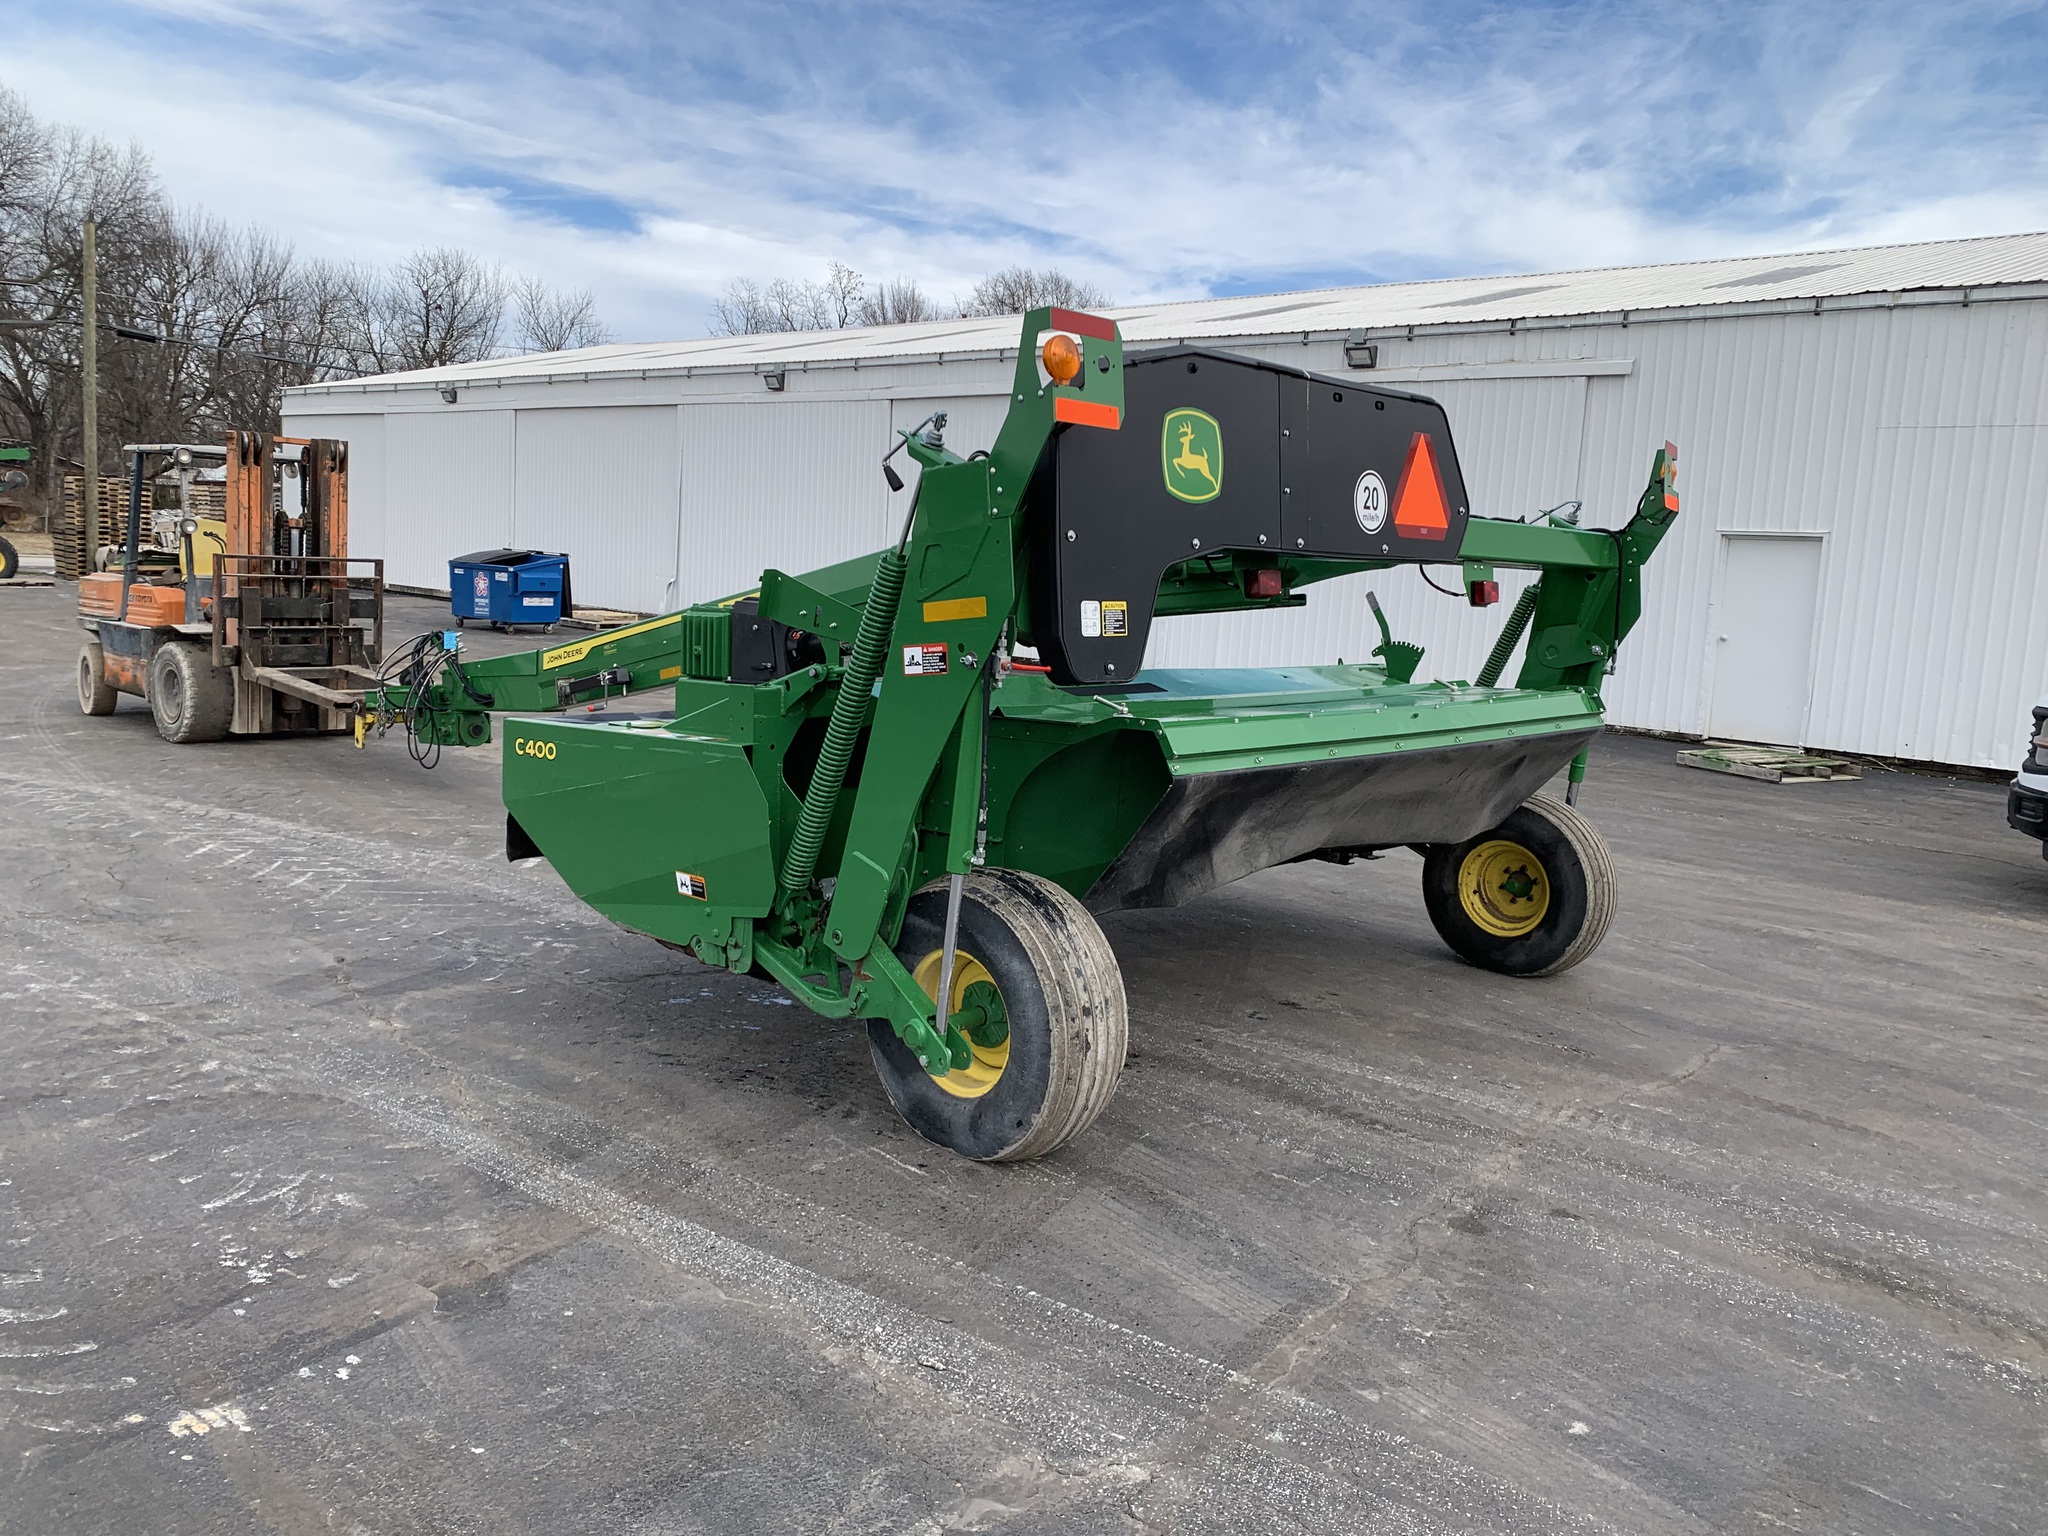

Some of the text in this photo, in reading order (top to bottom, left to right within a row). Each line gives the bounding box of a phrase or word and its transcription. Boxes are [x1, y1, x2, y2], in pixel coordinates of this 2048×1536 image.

[1363, 486, 1379, 511] 20
[135, 594, 153, 604] TOYOTA
[546, 647, 583, 664] JOHN DEERE
[515, 737, 557, 760] C400
